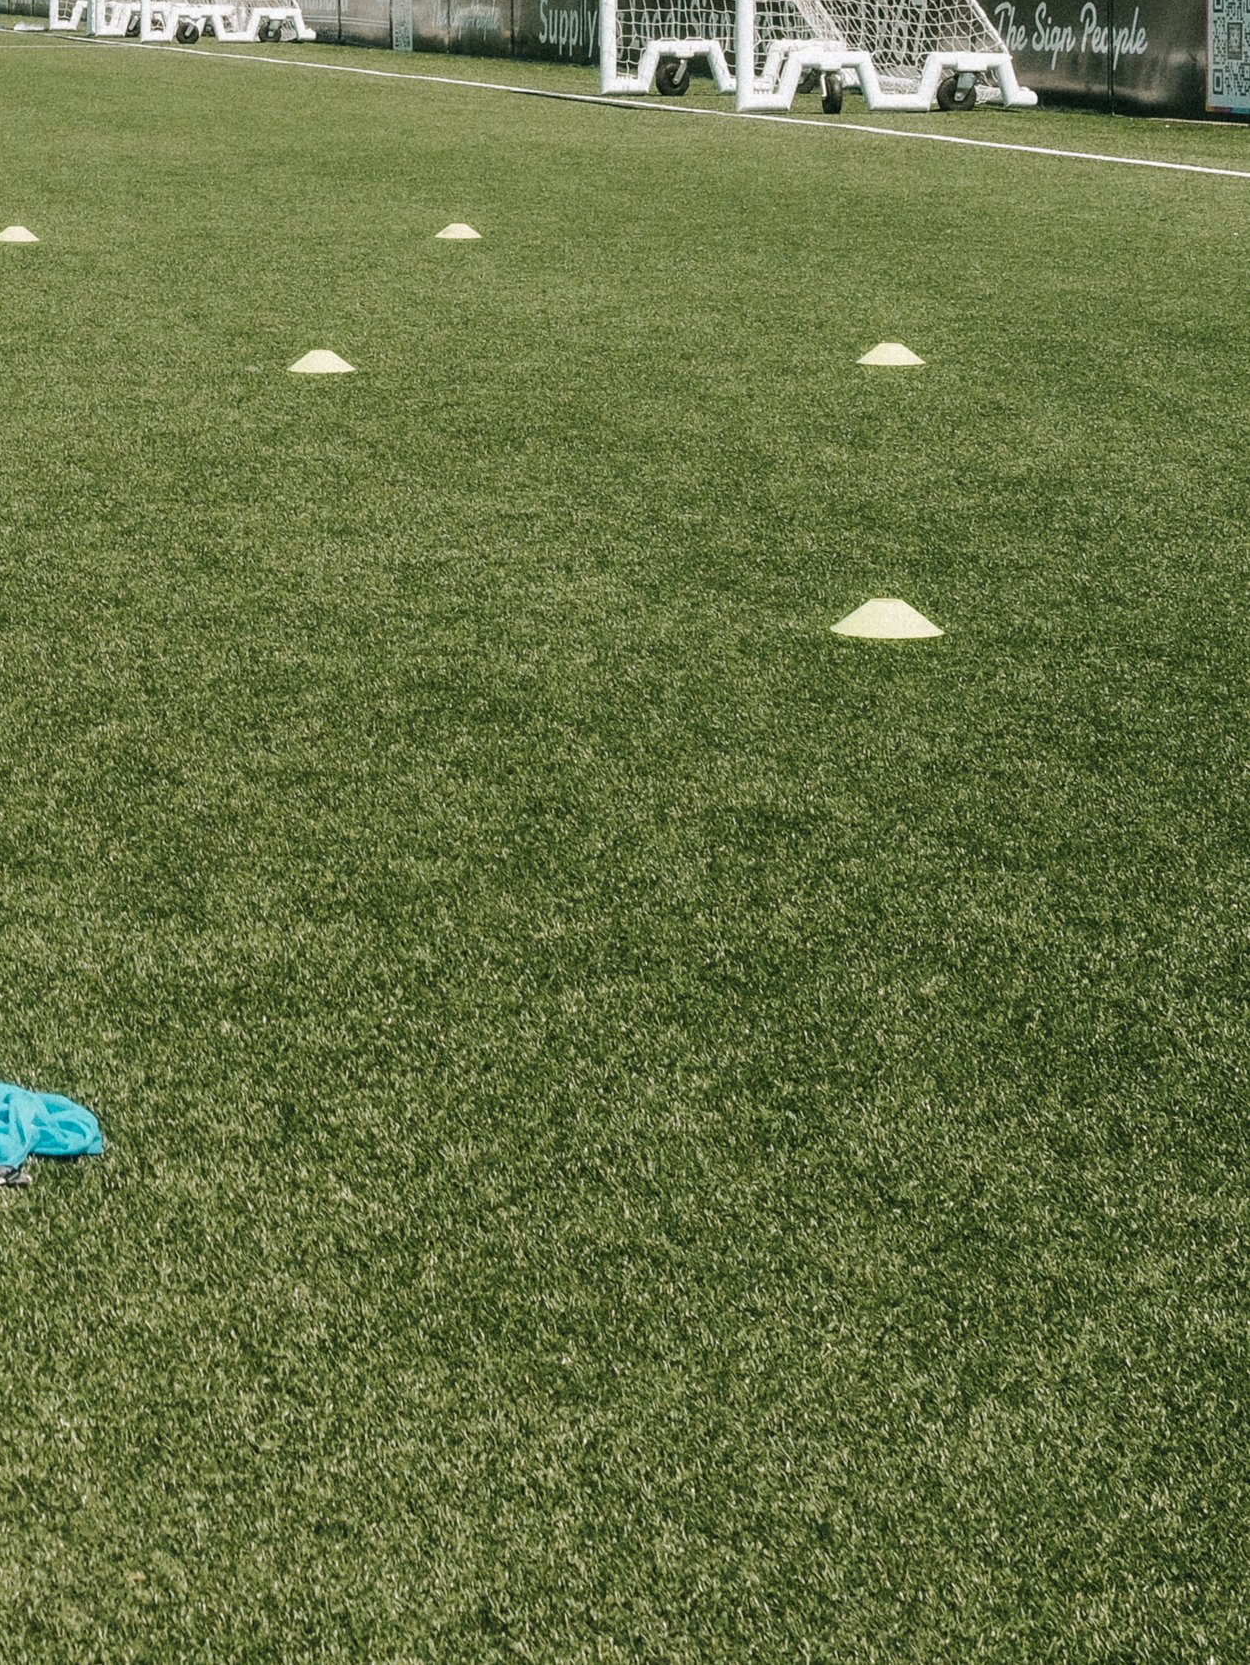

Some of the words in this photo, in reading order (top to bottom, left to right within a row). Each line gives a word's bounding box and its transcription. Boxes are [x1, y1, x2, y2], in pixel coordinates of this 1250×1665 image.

[993, 1, 1028, 52] The
[1032, 1, 1076, 71] Sign
[1079, 1, 1148, 71] People
